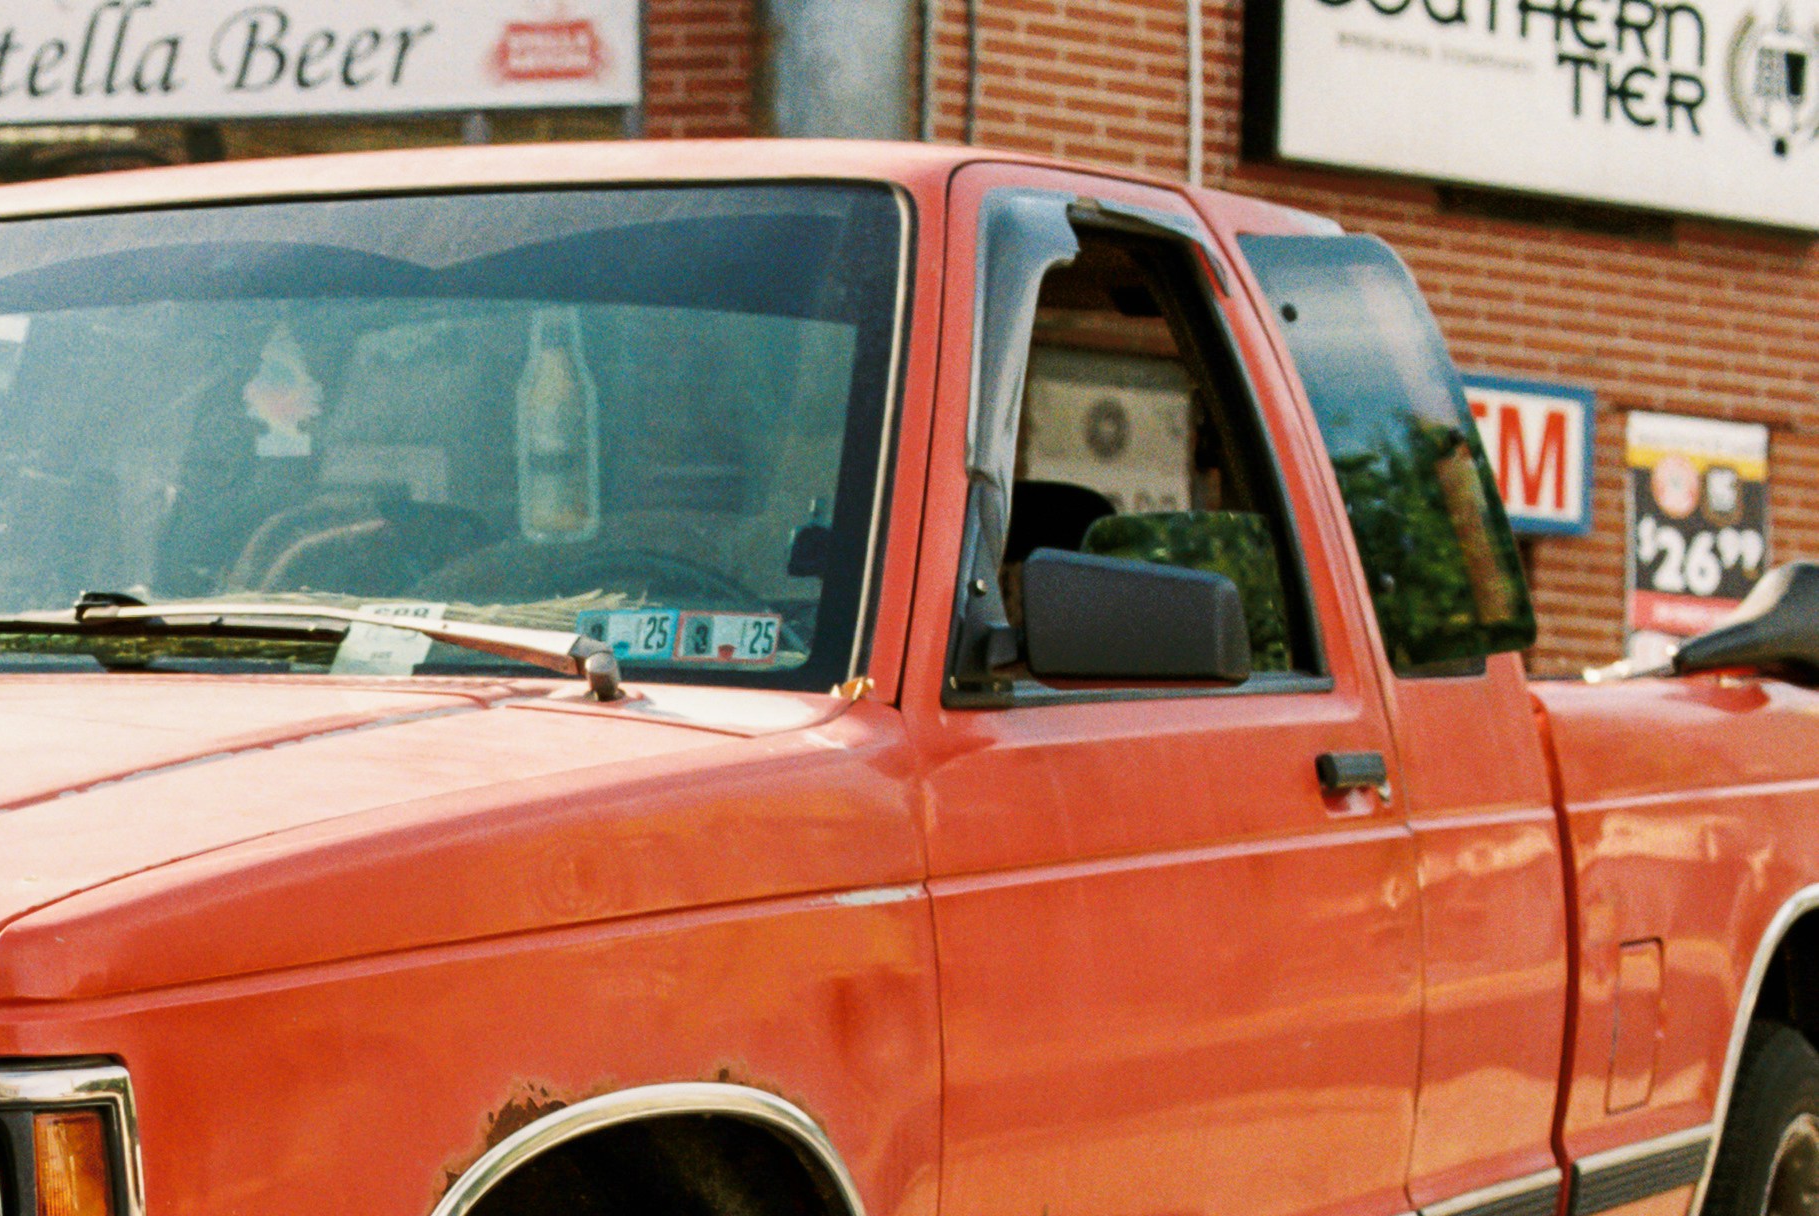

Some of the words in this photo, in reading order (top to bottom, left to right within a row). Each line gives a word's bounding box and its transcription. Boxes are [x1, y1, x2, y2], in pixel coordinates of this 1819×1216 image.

[210, 16, 432, 91] Beer
[1557, 53, 1706, 136] TIER
[643, 615, 671, 651] 25
[748, 620, 776, 655] 25
